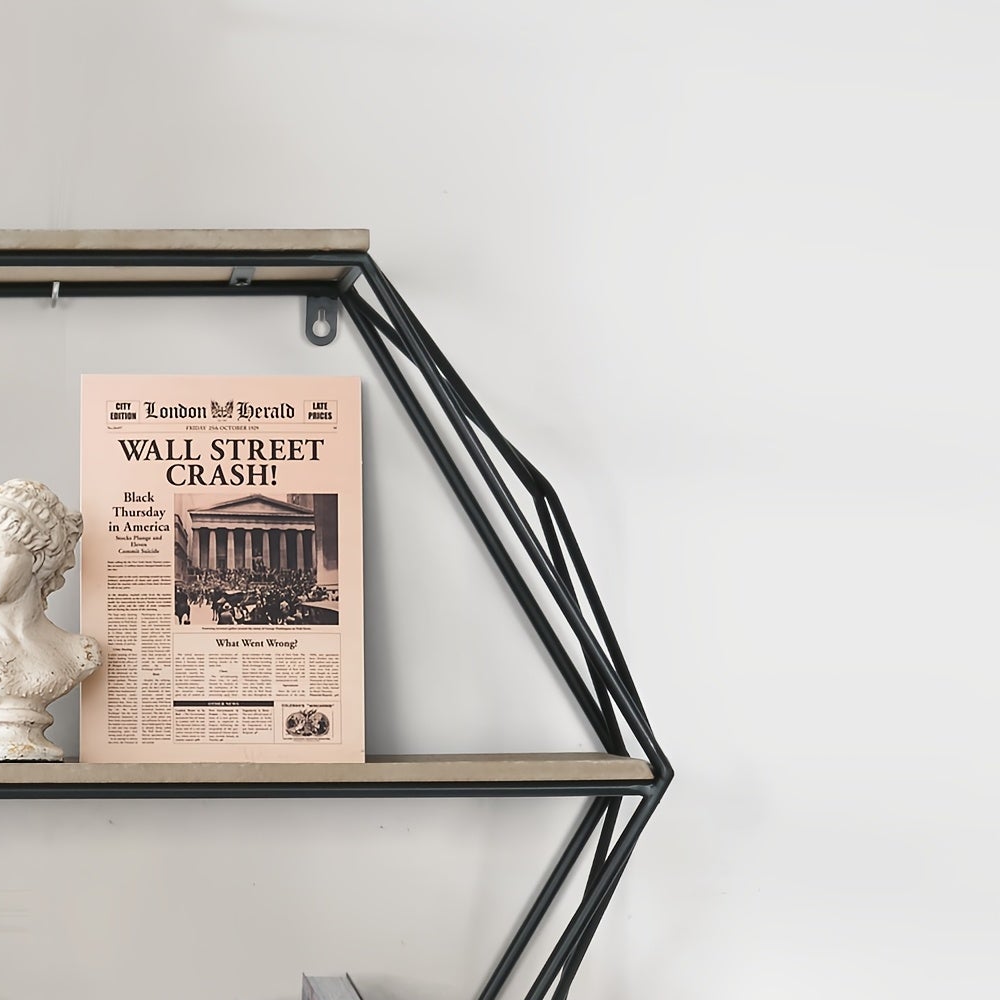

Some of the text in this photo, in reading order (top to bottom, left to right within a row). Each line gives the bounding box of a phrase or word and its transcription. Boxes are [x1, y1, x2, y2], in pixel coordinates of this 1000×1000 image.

[143, 401, 295, 421] London Herald
[313, 402, 327, 410] LATE
[110, 412, 136, 420] EDITION
[308, 412, 332, 420] PRICES
[118, 439, 324, 461] WALL STREET
[166, 464, 276, 486] CRASH!
[124, 492, 154, 502] Black
[112, 506, 166, 519] Thursday
[109, 521, 170, 532] in America
[215, 639, 298, 650] What Went Wrong?
